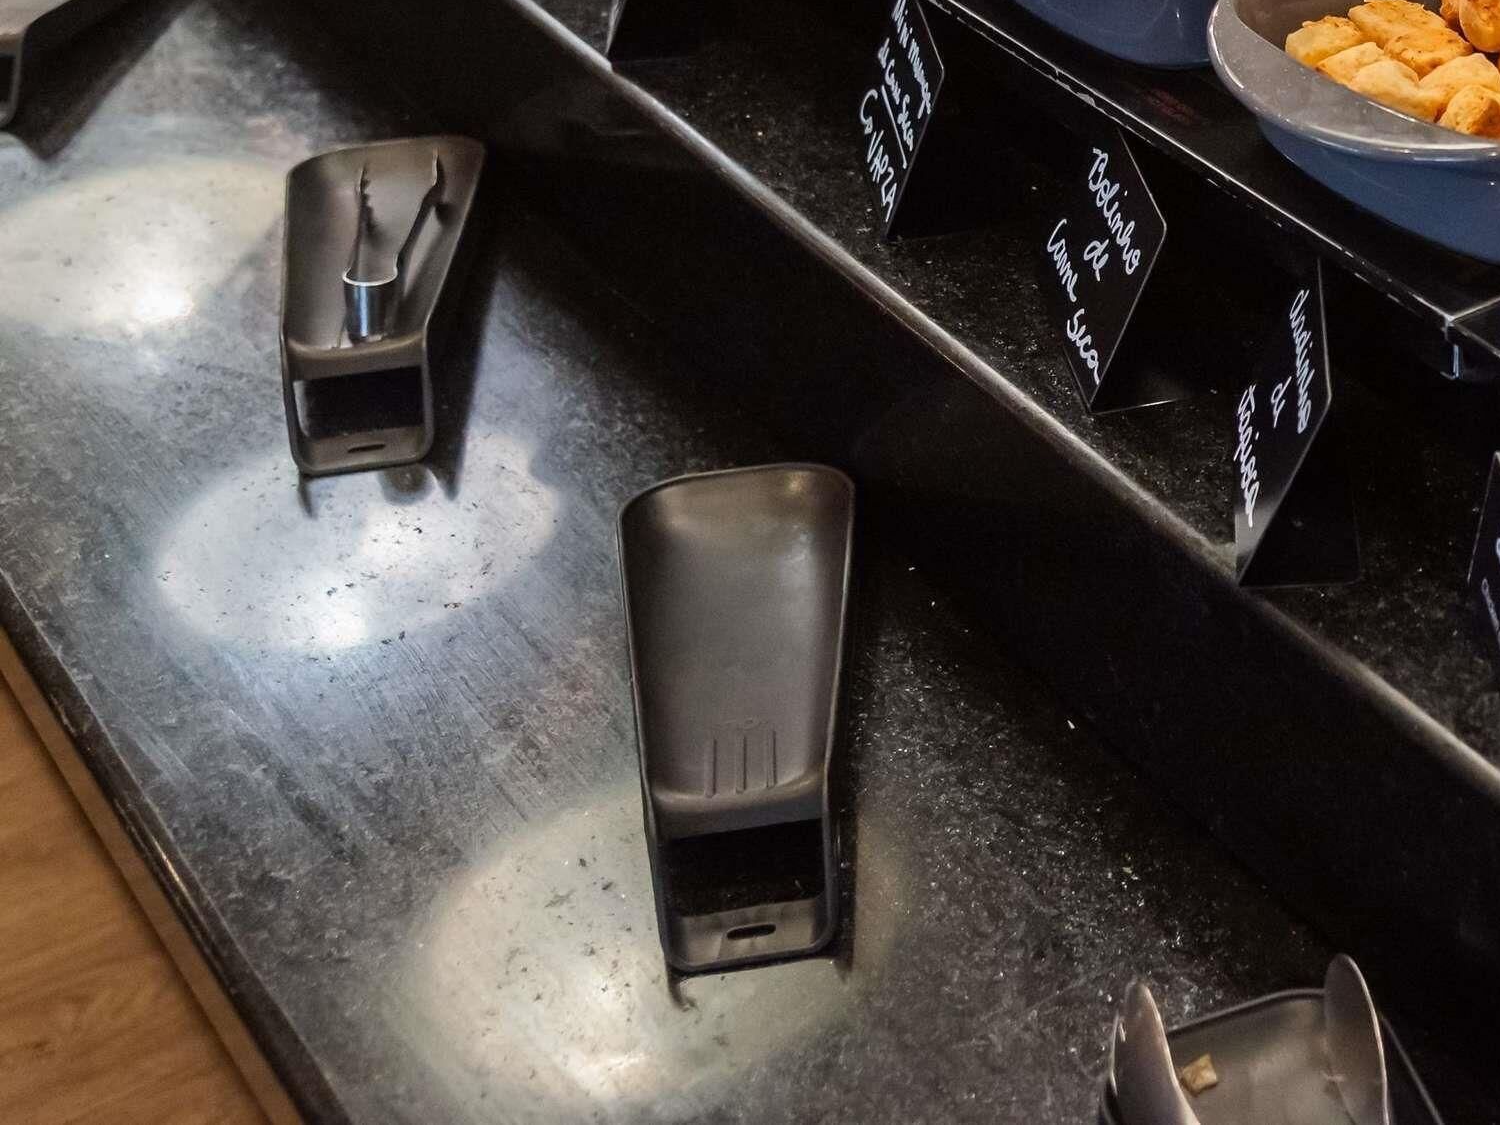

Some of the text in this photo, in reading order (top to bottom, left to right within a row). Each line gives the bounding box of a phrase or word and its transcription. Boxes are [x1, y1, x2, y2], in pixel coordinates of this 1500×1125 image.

[866, 130, 897, 223] VAPZA
[1088, 147, 1142, 276] Bolinho
[1083, 238, 1109, 282] de
[1271, 375, 1293, 429] de
